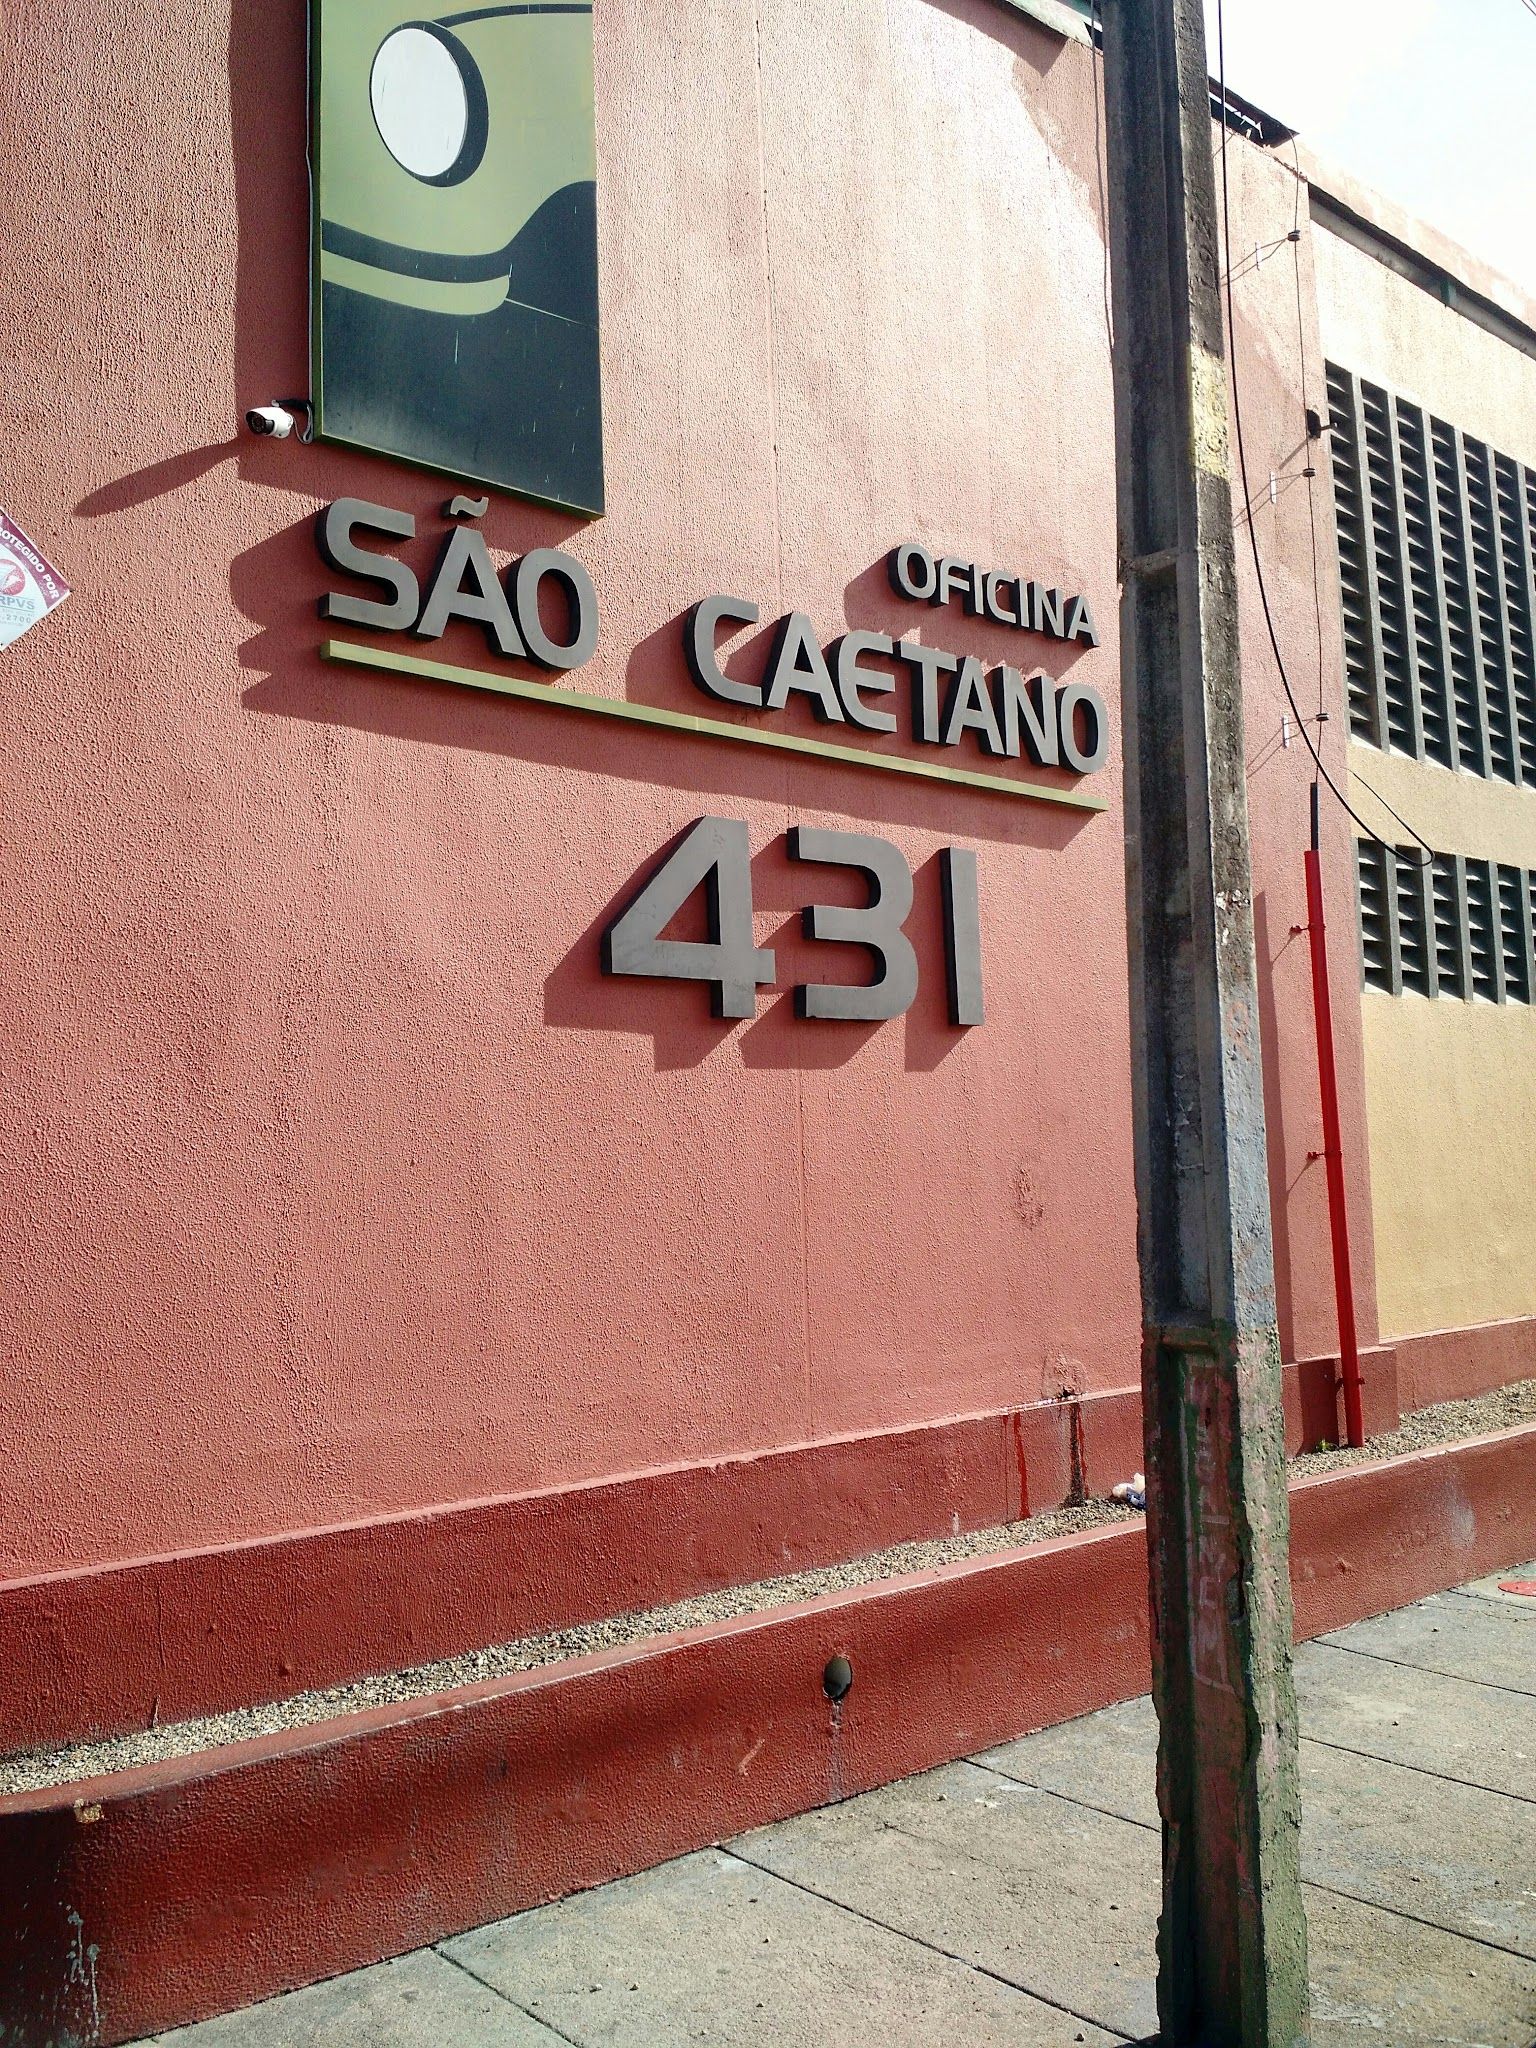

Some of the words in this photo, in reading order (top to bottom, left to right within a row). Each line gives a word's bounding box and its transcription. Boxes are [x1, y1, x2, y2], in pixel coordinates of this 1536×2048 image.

[0, 526, 46, 573] OTEGIDO
[42, 572, 60, 600] POR
[318, 495, 600, 670] SÃO
[685, 594, 1110, 775] CAETANO
[890, 543, 1100, 648] OFICINA
[602, 815, 985, 1026] 431
